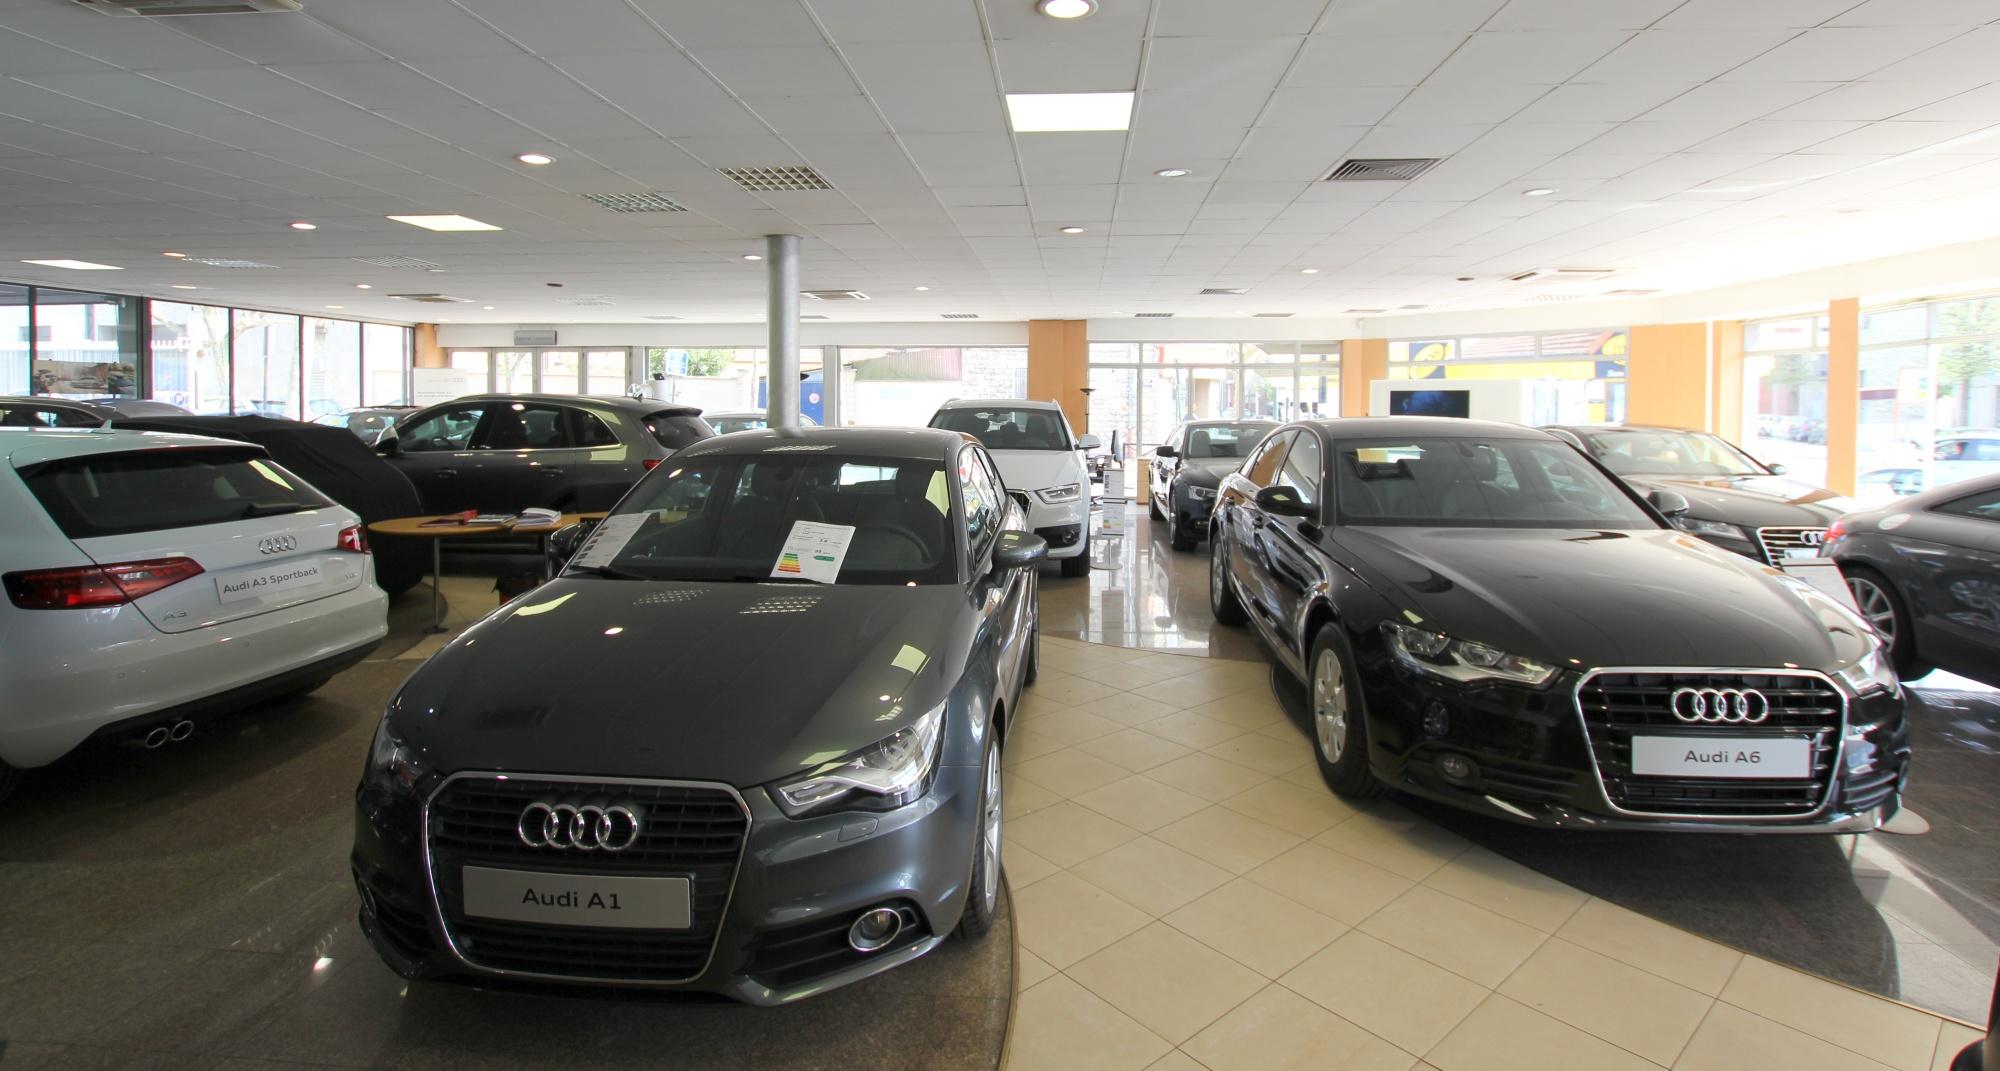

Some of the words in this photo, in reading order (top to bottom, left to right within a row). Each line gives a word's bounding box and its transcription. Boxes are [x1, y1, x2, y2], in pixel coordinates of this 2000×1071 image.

[223, 581, 250, 594] Audi
[252, 577, 268, 588] A3
[269, 567, 318, 584] Sportback
[162, 611, 188, 621] A3
[1684, 750, 1728, 763] Audi
[1735, 751, 1761, 764] A6
[522, 888, 578, 907] Audi
[587, 893, 622, 910] A1
